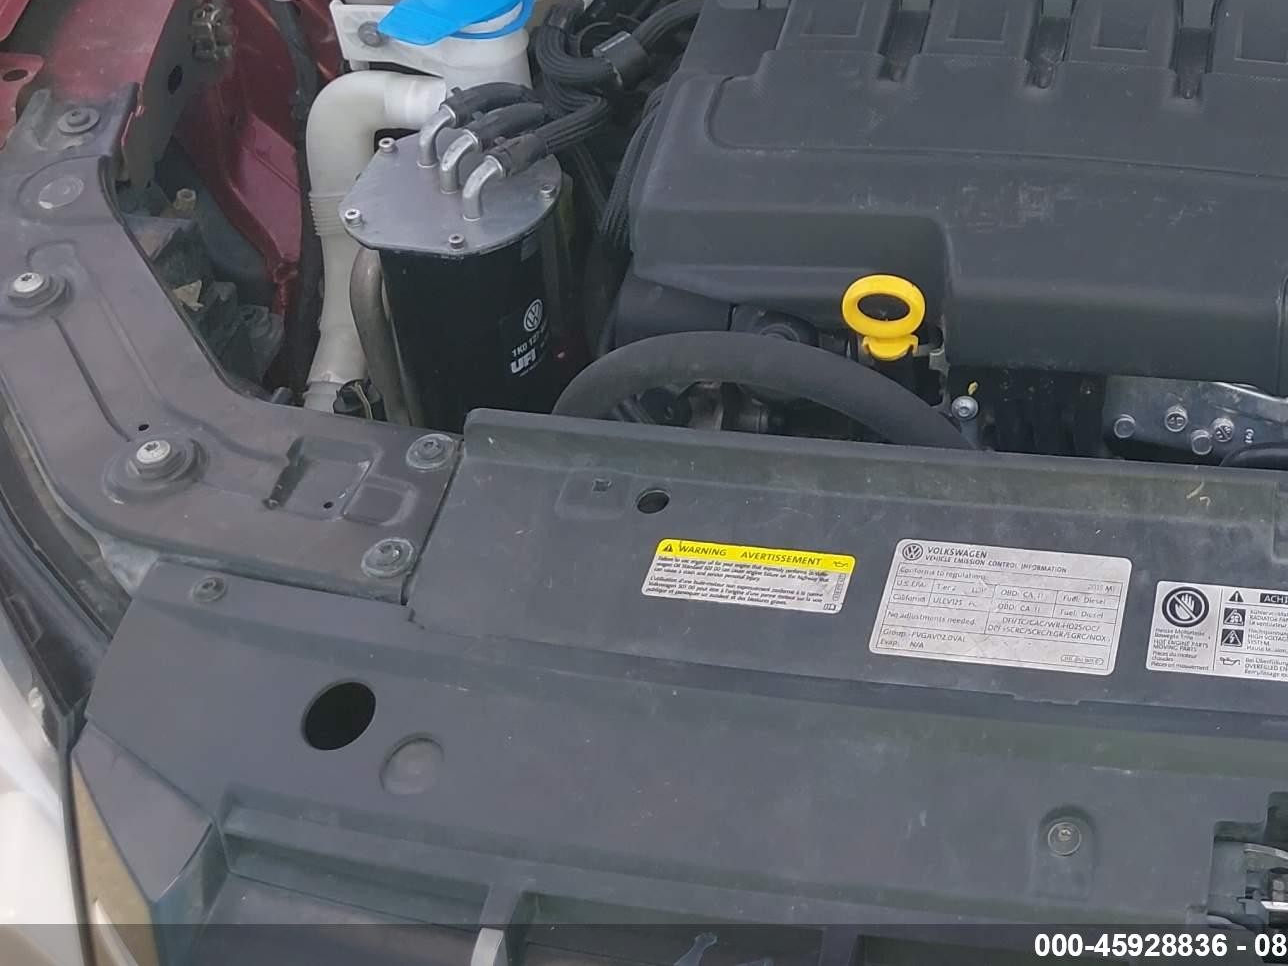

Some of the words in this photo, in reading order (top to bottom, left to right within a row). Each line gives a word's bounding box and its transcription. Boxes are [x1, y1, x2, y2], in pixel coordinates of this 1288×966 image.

[510, 348, 537, 374] UFI
[677, 545, 727, 556] WARNING
[740, 551, 821, 565] AVERTISSEMENT
[926, 545, 987, 558] VOLKSWAGEN
[953, 557, 985, 565] EMISSION
[987, 560, 1017, 568] CONTROL
[1020, 563, 1068, 573] INFORMATION
[1083, 596, 1106, 604] Diesel
[899, 612, 945, 623] adjustments
[946, 616, 977, 626] needed.
[909, 641, 925, 649] N/A
